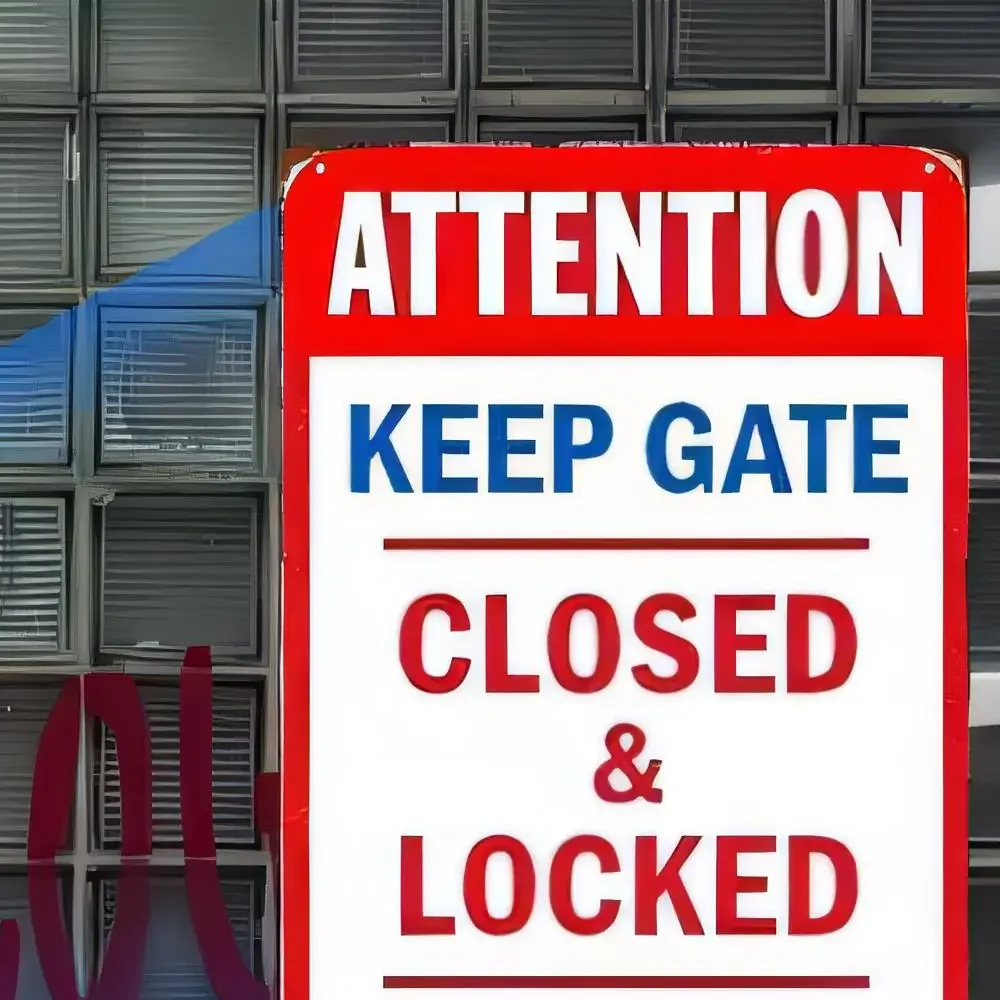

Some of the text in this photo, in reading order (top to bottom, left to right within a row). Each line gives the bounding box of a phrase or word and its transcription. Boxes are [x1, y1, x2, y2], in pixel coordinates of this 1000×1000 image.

[328, 189, 924, 318] ATTENTION
[350, 402, 909, 494] KEEP GATE
[398, 592, 858, 695] CLOSED
[593, 722, 663, 804] &
[400, 834, 859, 936] LOCKED
